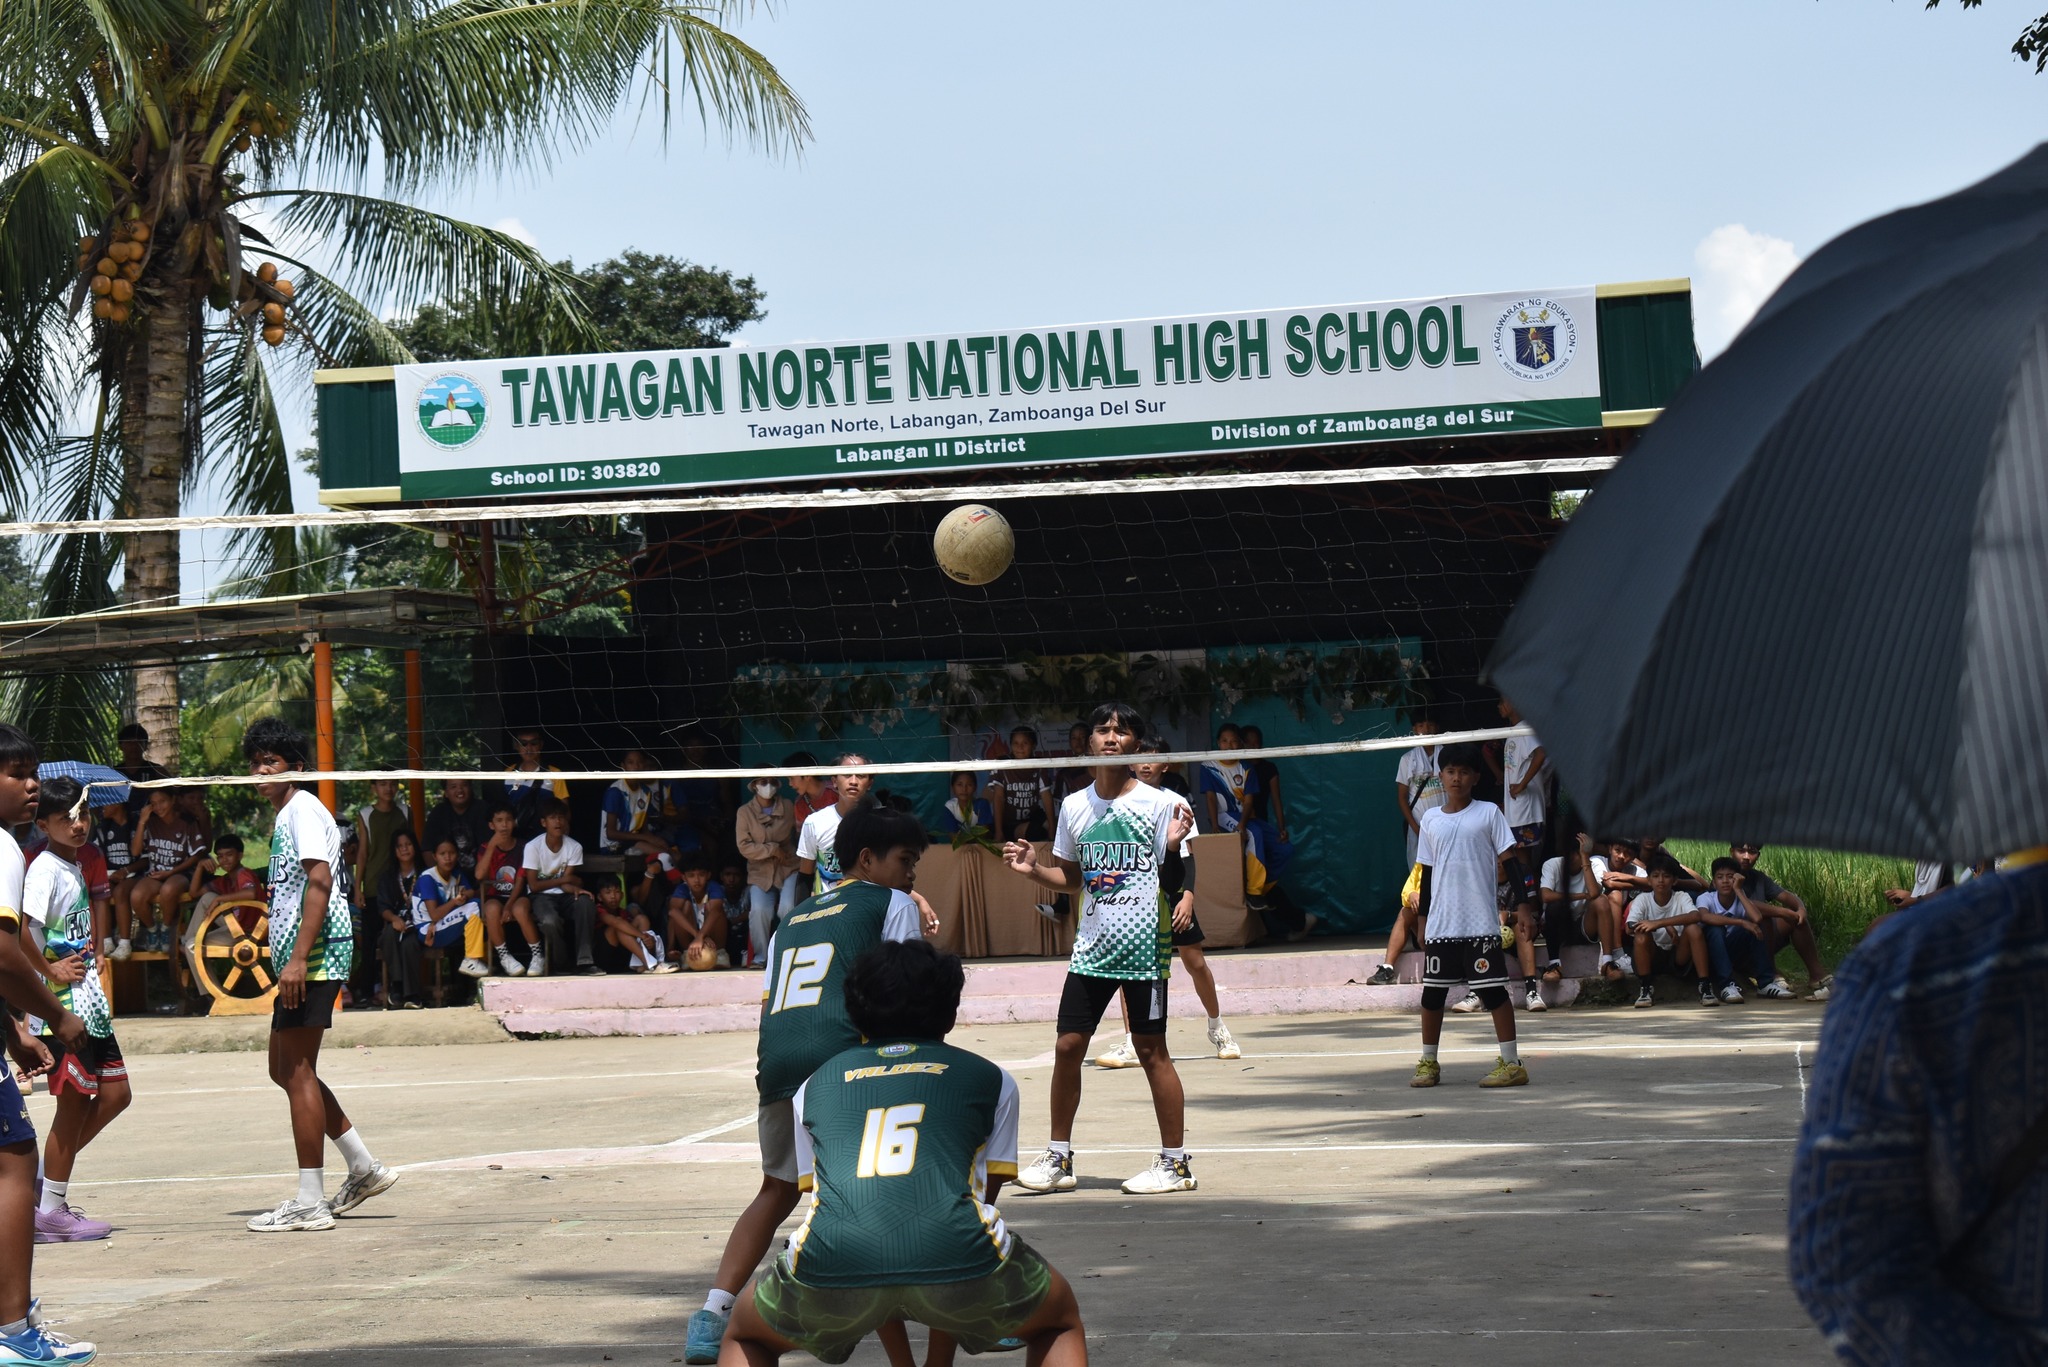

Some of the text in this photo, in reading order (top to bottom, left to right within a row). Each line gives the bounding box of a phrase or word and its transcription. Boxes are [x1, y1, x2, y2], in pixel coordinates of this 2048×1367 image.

[1493, 298, 1577, 351] KAGAWARAN NG EDUKASYON
[501, 304, 1480, 428] TAWAGAN NORTE NATIONAL HIGH SCHOOL
[1503, 361, 1533, 380] REPUBLIKA
[1546, 357, 1570, 377] PILIPINAS
[747, 399, 1167, 439] Tawagan Norte, Labangan, Zamboanga Del Sur
[1211, 408, 1514, 441] Division of Zamboanga del Sur
[836, 437, 1026, 463] Labangan II District
[490, 461, 661, 486] School ID: 303820
[770, 942, 835, 1015] 12
[1426, 955, 1441, 974] 10
[844, 1062, 949, 1083] VALDEZ
[857, 1103, 926, 1178] 16
